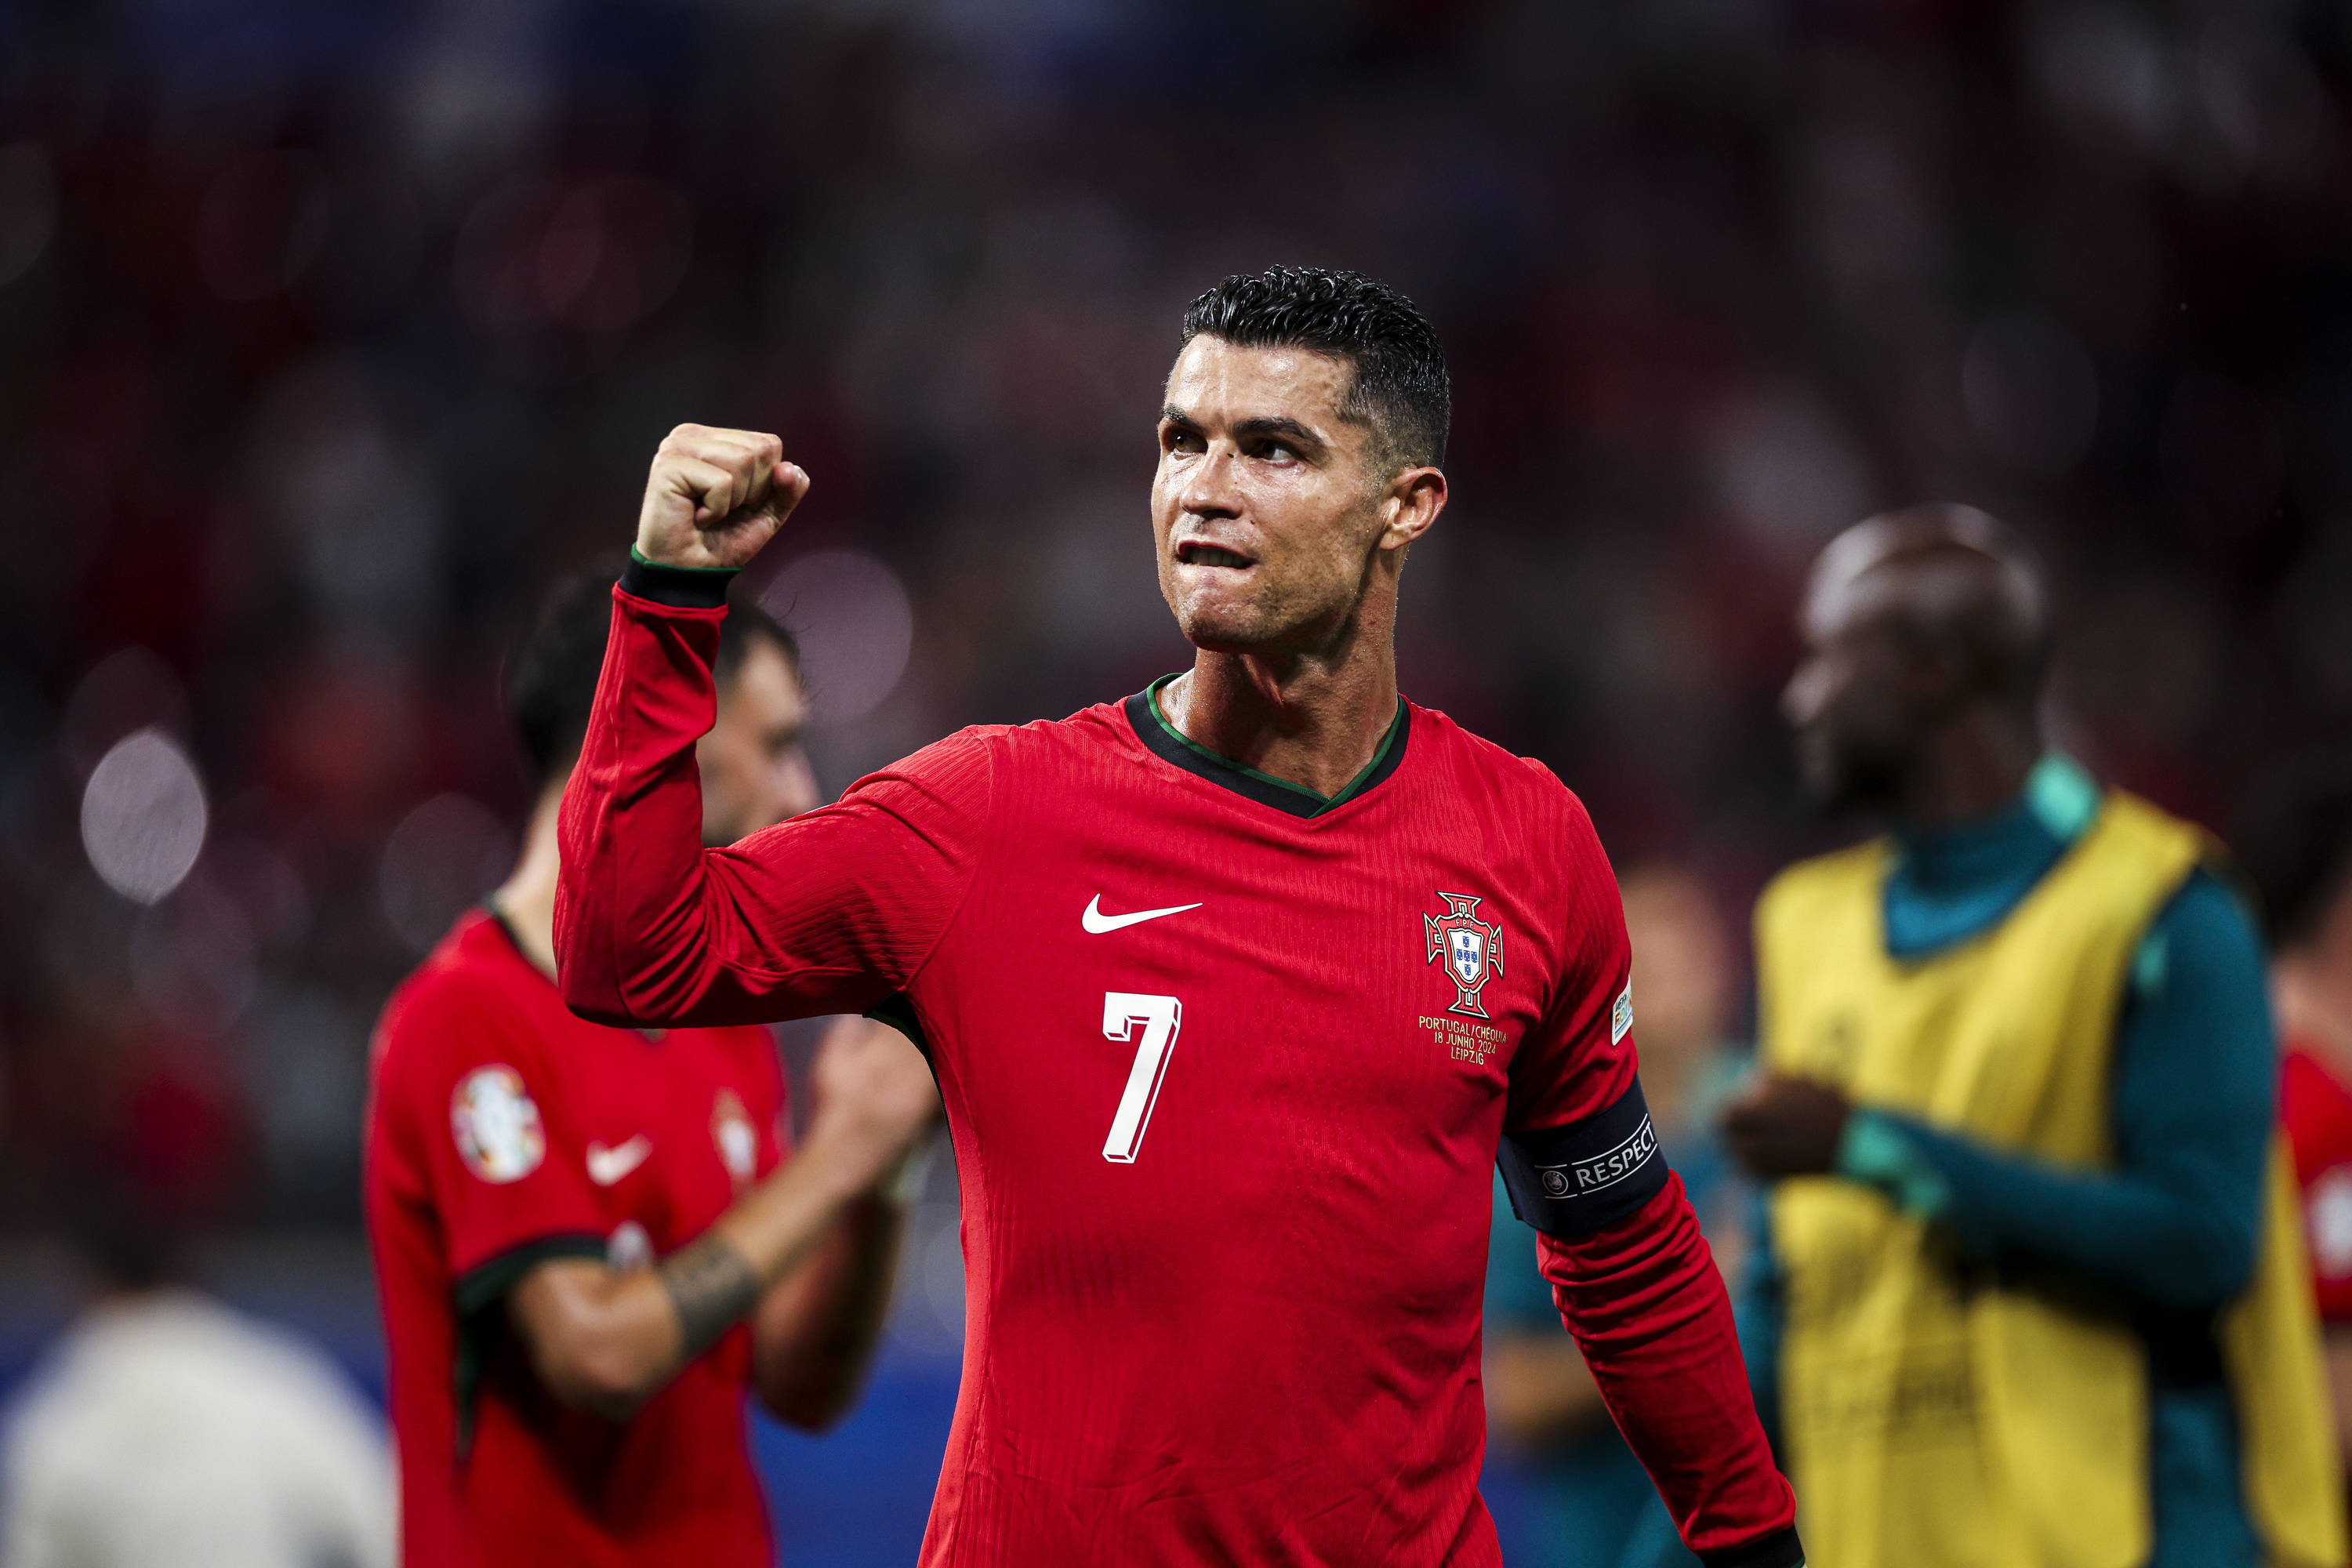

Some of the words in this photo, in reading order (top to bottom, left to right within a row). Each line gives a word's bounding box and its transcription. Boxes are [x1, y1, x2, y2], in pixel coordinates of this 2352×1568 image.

[1435, 1031, 1443, 1044] 18
[1446, 1033, 1475, 1050] JUNHO
[1478, 1040, 1497, 1054] 2024
[1450, 1046, 1484, 1065] LEIPZIG
[1102, 991, 1182, 1164] 7
[1576, 1121, 1654, 1187] RESPECT
